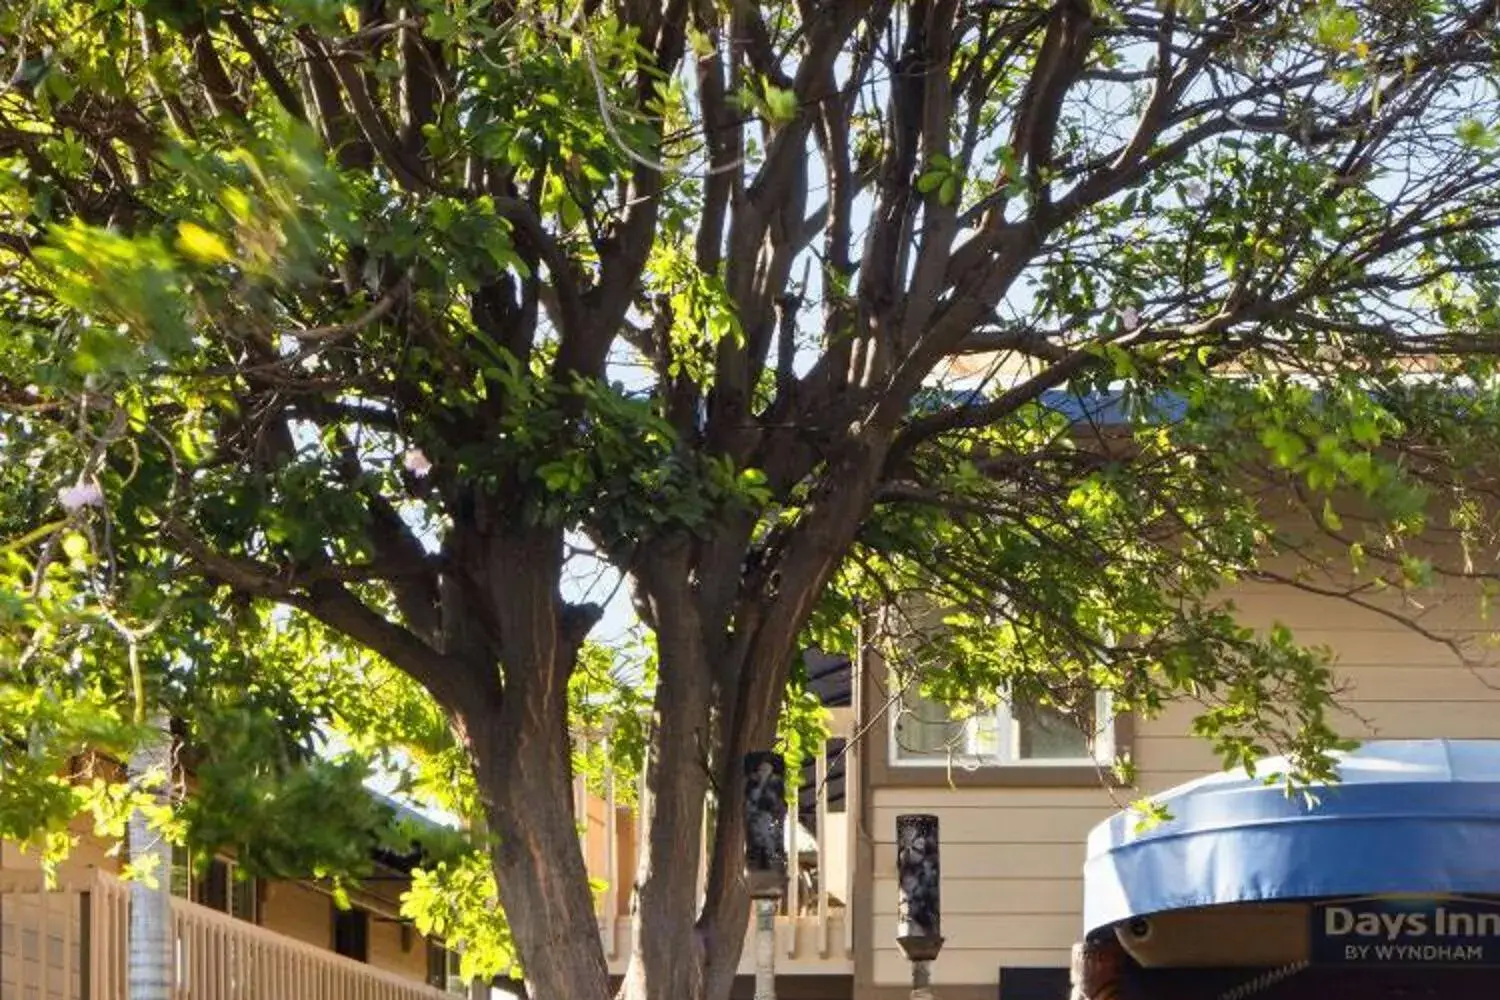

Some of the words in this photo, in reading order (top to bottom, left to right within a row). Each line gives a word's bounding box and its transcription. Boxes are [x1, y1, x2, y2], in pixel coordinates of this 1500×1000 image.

[1325, 907, 1427, 940] Days
[1345, 945, 1372, 960] BY
[1374, 945, 1483, 960] WYNDHAM
